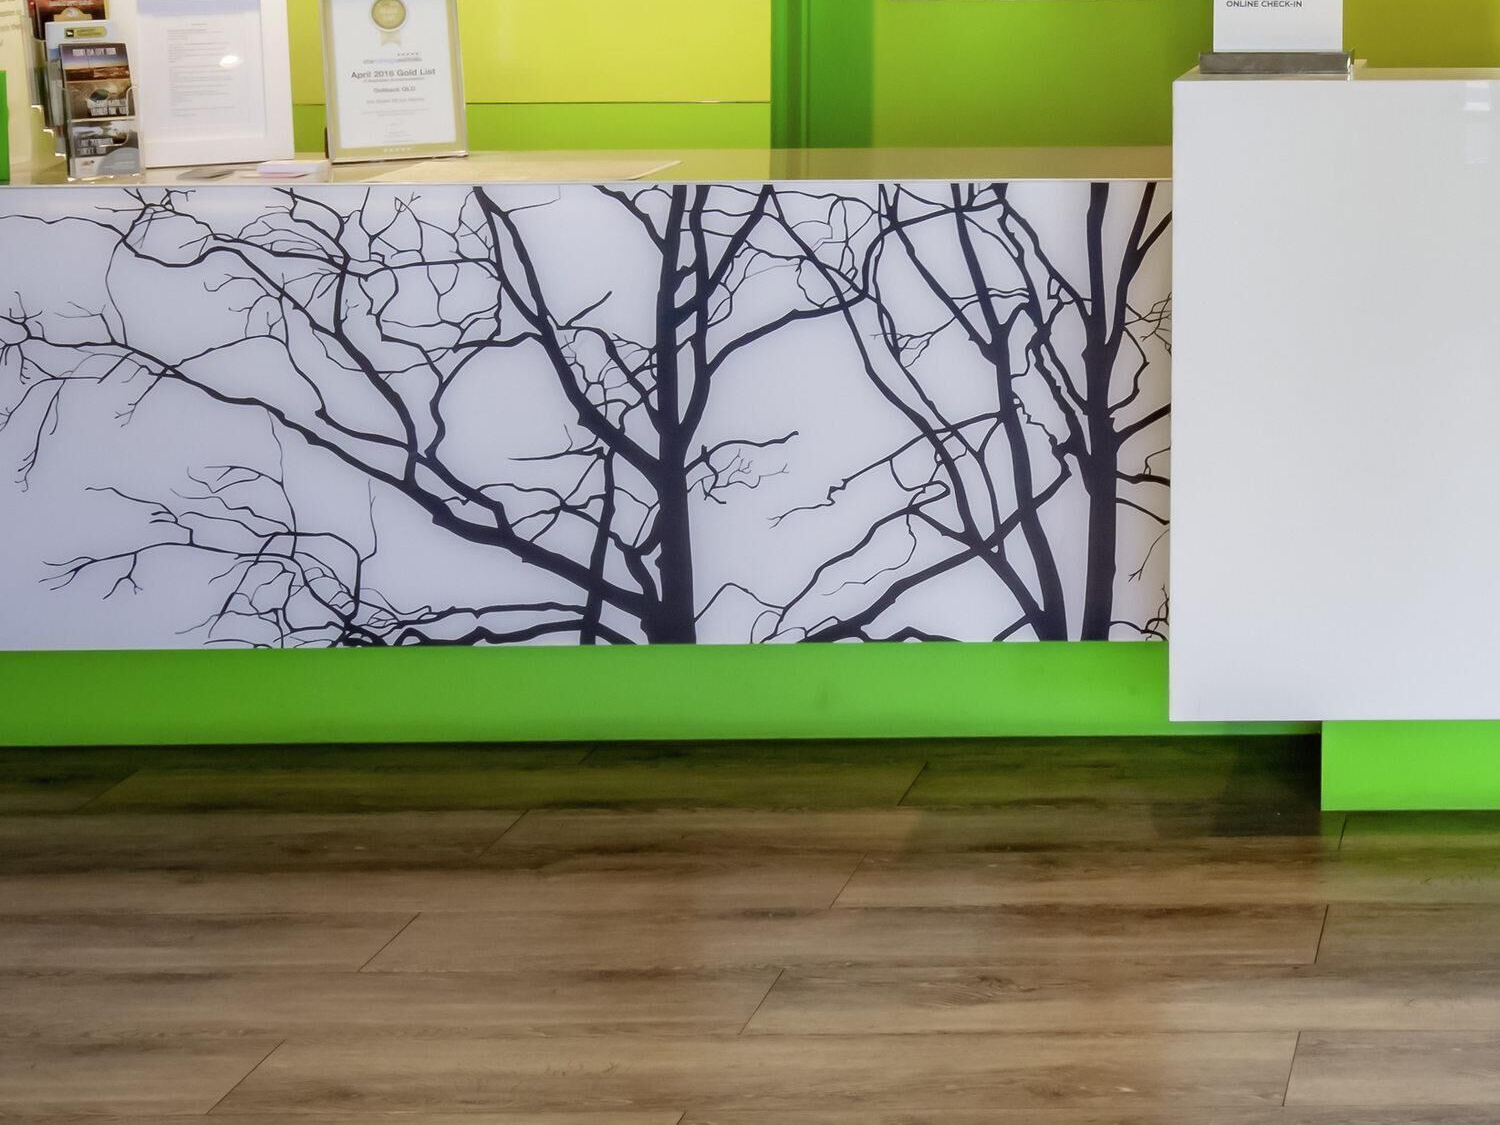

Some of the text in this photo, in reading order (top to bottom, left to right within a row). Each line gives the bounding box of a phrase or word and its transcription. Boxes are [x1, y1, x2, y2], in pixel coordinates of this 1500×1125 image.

[1225, 0, 1303, 8] ONLINE CHECK-IN
[351, 71, 371, 80] April
[374, 70, 394, 79] 2016
[397, 69, 418, 77] Gold
[420, 68, 436, 76] List
